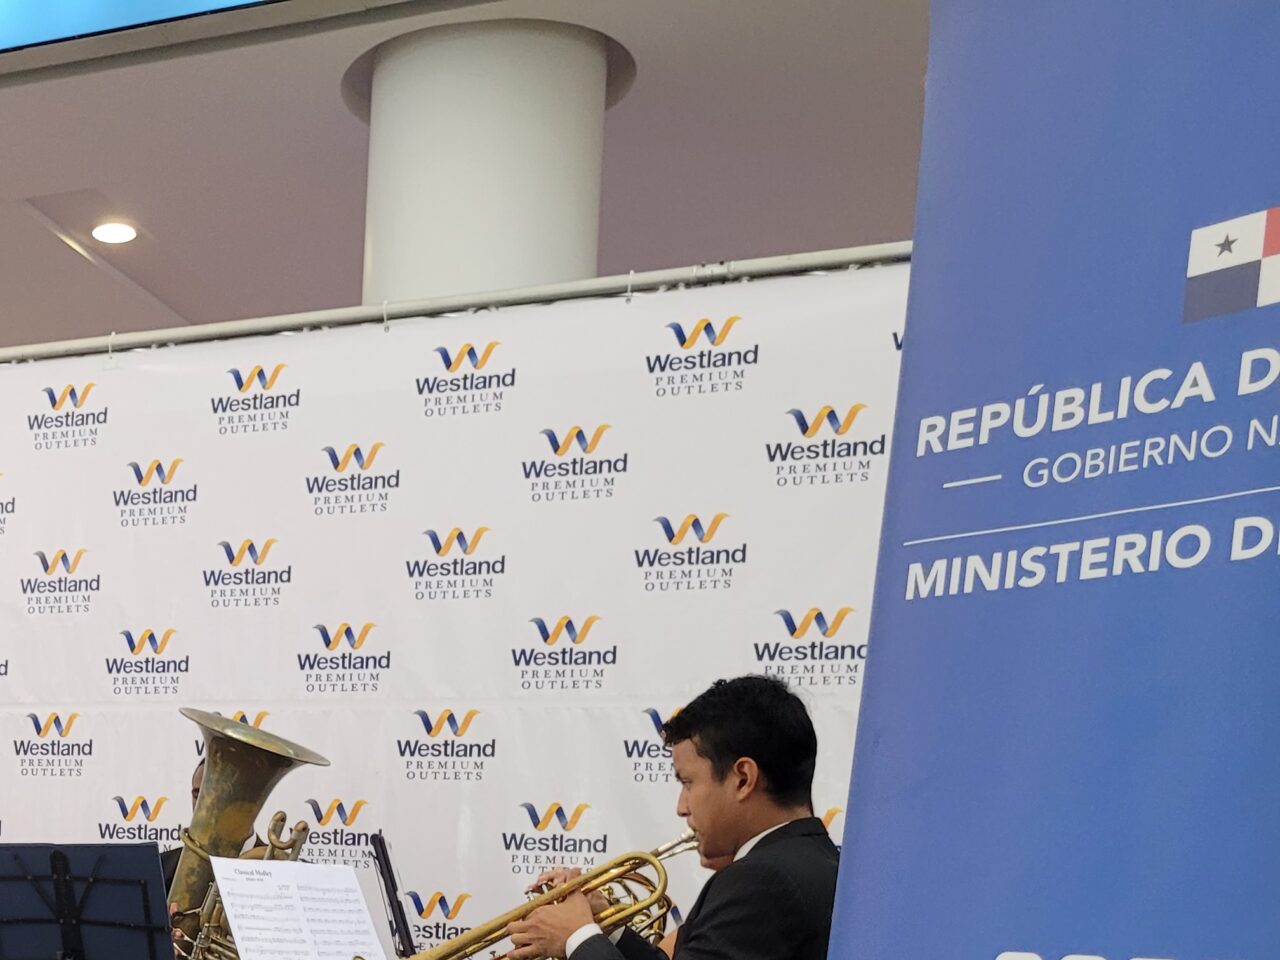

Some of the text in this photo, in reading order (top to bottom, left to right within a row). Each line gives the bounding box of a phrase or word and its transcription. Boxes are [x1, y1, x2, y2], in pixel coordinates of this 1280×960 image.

[646, 345, 759, 374] Westland
[416, 369, 516, 395] Westland
[655, 370, 745, 385] PREMIUM
[656, 381, 744, 397] OUTLETS
[211, 389, 300, 414] Westland
[425, 392, 503, 407] PREMIUM
[425, 403, 501, 417] OUTLETS
[915, 362, 1216, 458] REPÚBLICA
[27, 408, 108, 430] Westland
[219, 411, 288, 424] PREMIUM
[35, 428, 97, 440] PREMIUM
[219, 422, 287, 434] OUTLETS
[35, 439, 96, 449] OUTLETS
[765, 434, 885, 462] Westland
[1022, 423, 1234, 489] GOBIERNO
[522, 453, 628, 479] Westland
[776, 460, 871, 476] PREMIUM
[306, 469, 400, 494] Westland
[532, 477, 614, 491] PREMIUM
[776, 470, 869, 487] OUTLETS
[113, 485, 197, 506] Westland
[314, 493, 388, 505] PREMIUM
[532, 489, 612, 502] OUTLETS
[121, 506, 186, 517] PREMIUM
[315, 503, 386, 515] OUTLETS
[121, 516, 185, 526] OUTLETS
[634, 543, 747, 568] Westland
[905, 524, 1211, 601] MINISTERIO
[406, 555, 505, 578] Westland
[203, 565, 291, 586] Westland
[644, 568, 733, 580] PREMIUM
[20, 575, 100, 594] Westland
[415, 578, 493, 589] PREMIUM
[644, 578, 732, 591] OUTLETS
[211, 587, 280, 597] PREMIUM
[415, 589, 491, 600] OUTLETS
[28, 595, 90, 604] PREMIUM
[211, 598, 279, 607] OUTLETS
[28, 605, 89, 614] OUTLETS
[297, 651, 391, 670] Westland
[512, 645, 617, 666] Westland
[105, 655, 189, 674] Westland
[765, 664, 859, 674] PREMIUM
[113, 676, 179, 685] PREMIUM
[306, 673, 379, 682] PREMIUM
[521, 669, 604, 679] PREMIUM
[114, 686, 177, 694] OUTLETS
[306, 683, 377, 692] OUTLETS
[522, 680, 602, 689] OUTLETS
[13, 739, 93, 756] Westland
[397, 739, 496, 758] Westland
[21, 768, 81, 776] OUTLETS
[406, 761, 483, 769] PREMIUM
[407, 771, 482, 780] OUTLETS
[98, 823, 182, 841] Westland
[502, 832, 607, 853] Westland
[511, 855, 595, 866] PREMIUM
